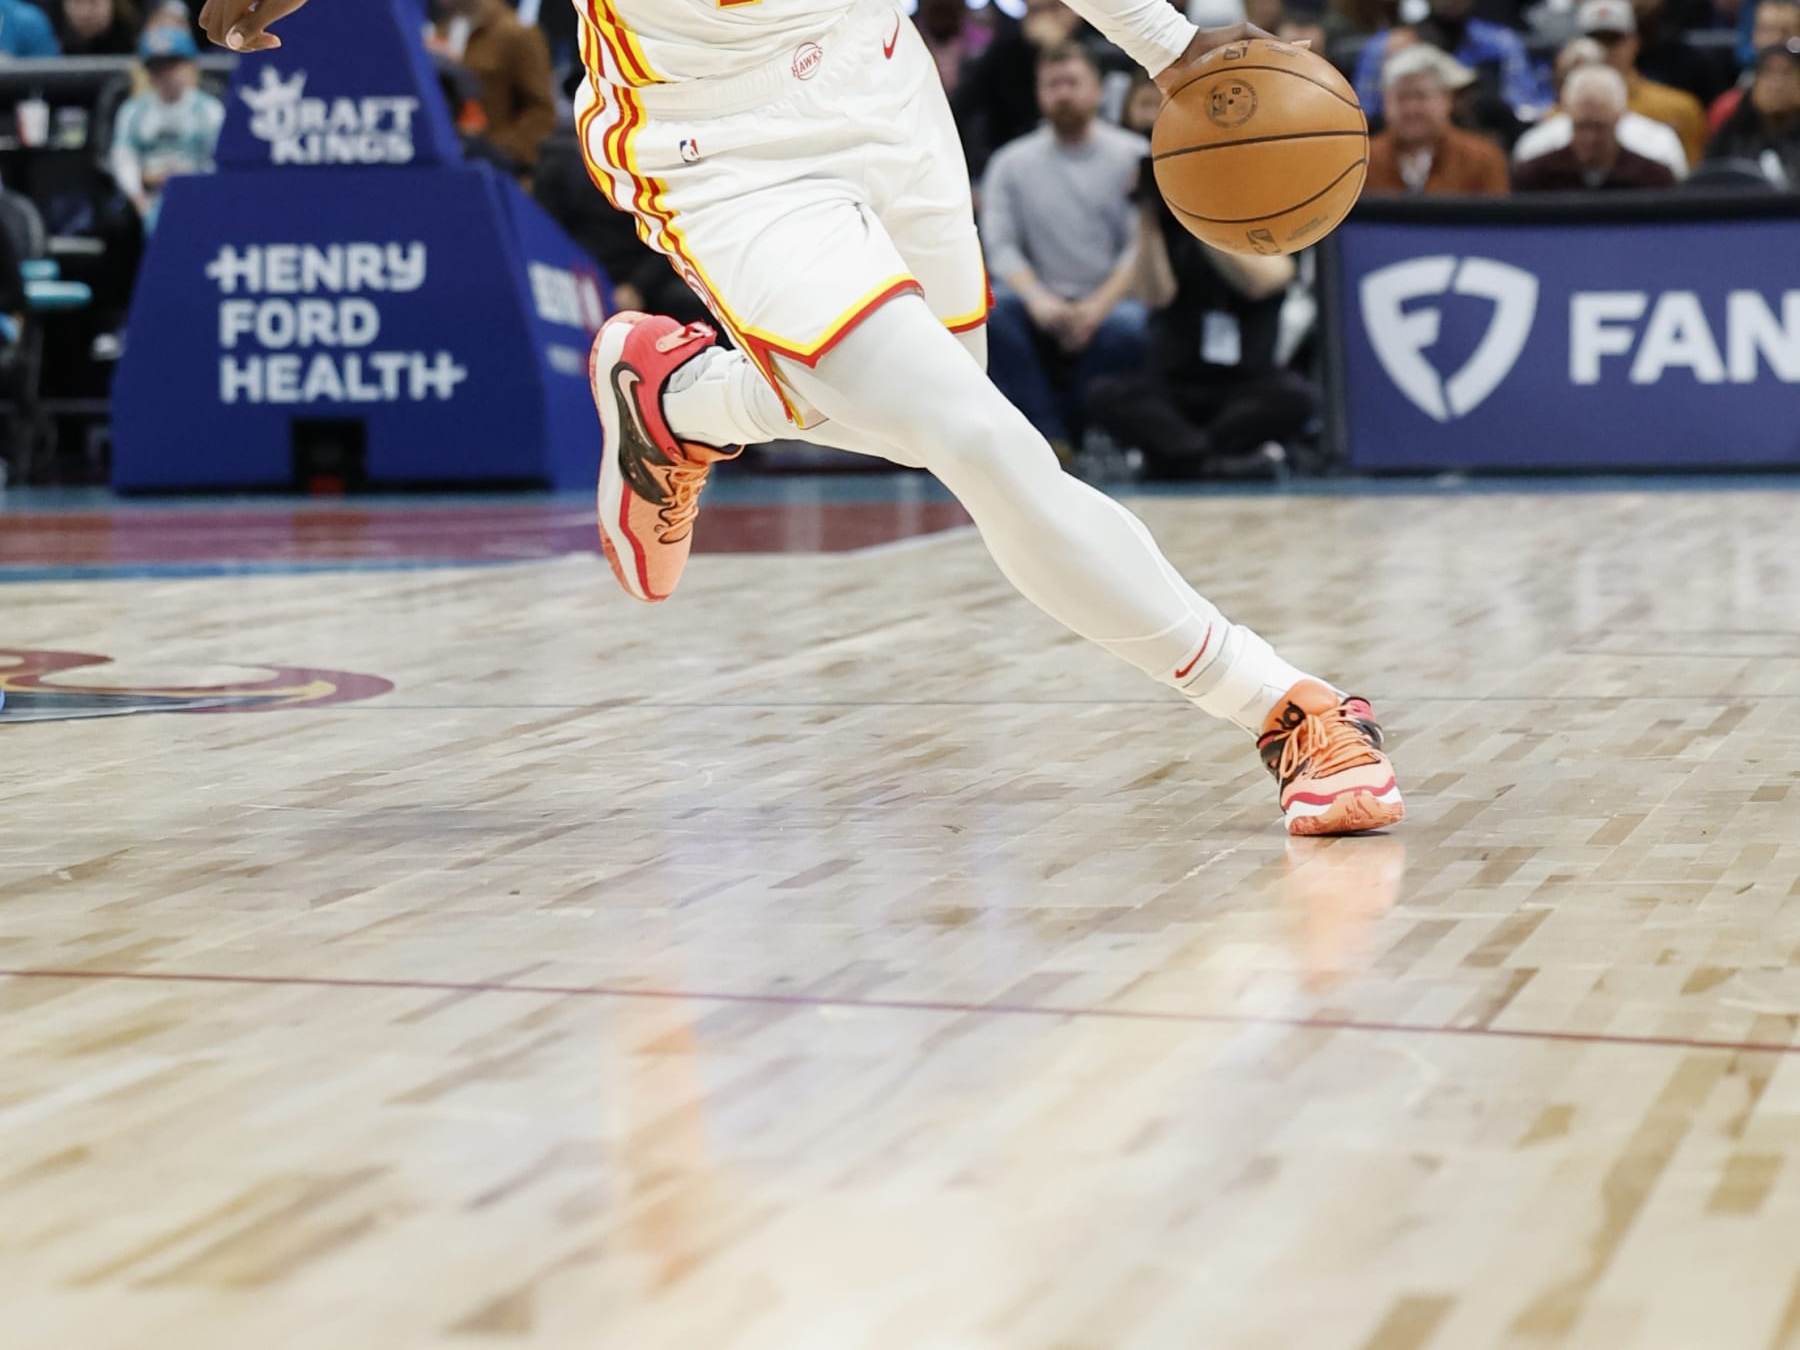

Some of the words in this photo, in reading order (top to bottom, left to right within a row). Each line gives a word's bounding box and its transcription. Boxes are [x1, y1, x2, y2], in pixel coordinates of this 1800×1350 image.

[271, 132, 415, 165] KINGS
[205, 241, 427, 294] HENRY
[219, 297, 381, 349] FORD
[1569, 289, 1800, 385] FAN
[220, 351, 468, 404] HEALTH
